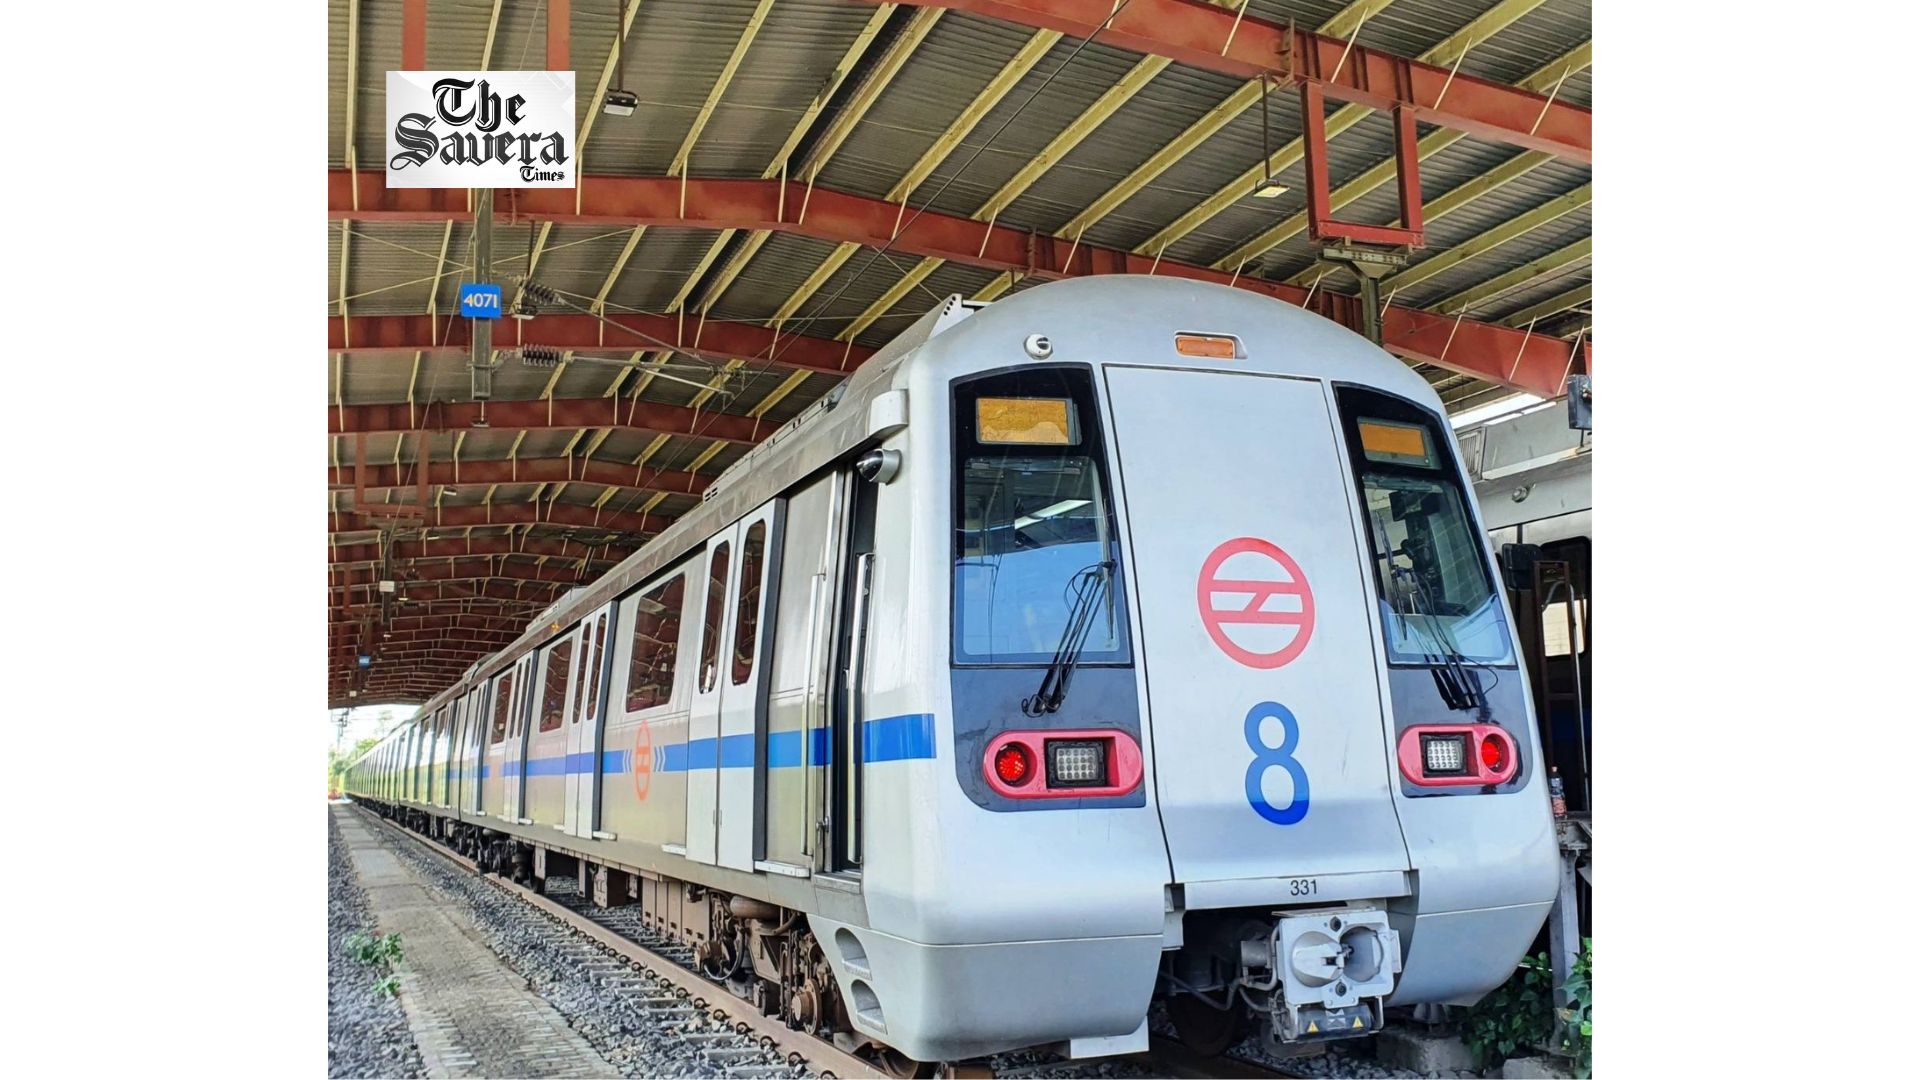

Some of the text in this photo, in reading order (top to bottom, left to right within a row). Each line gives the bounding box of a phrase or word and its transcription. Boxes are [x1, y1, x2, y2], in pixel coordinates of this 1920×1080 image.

[463, 293, 498, 308] 4071
[1244, 701, 1310, 825] 8
[1290, 880, 1318, 896] 331
